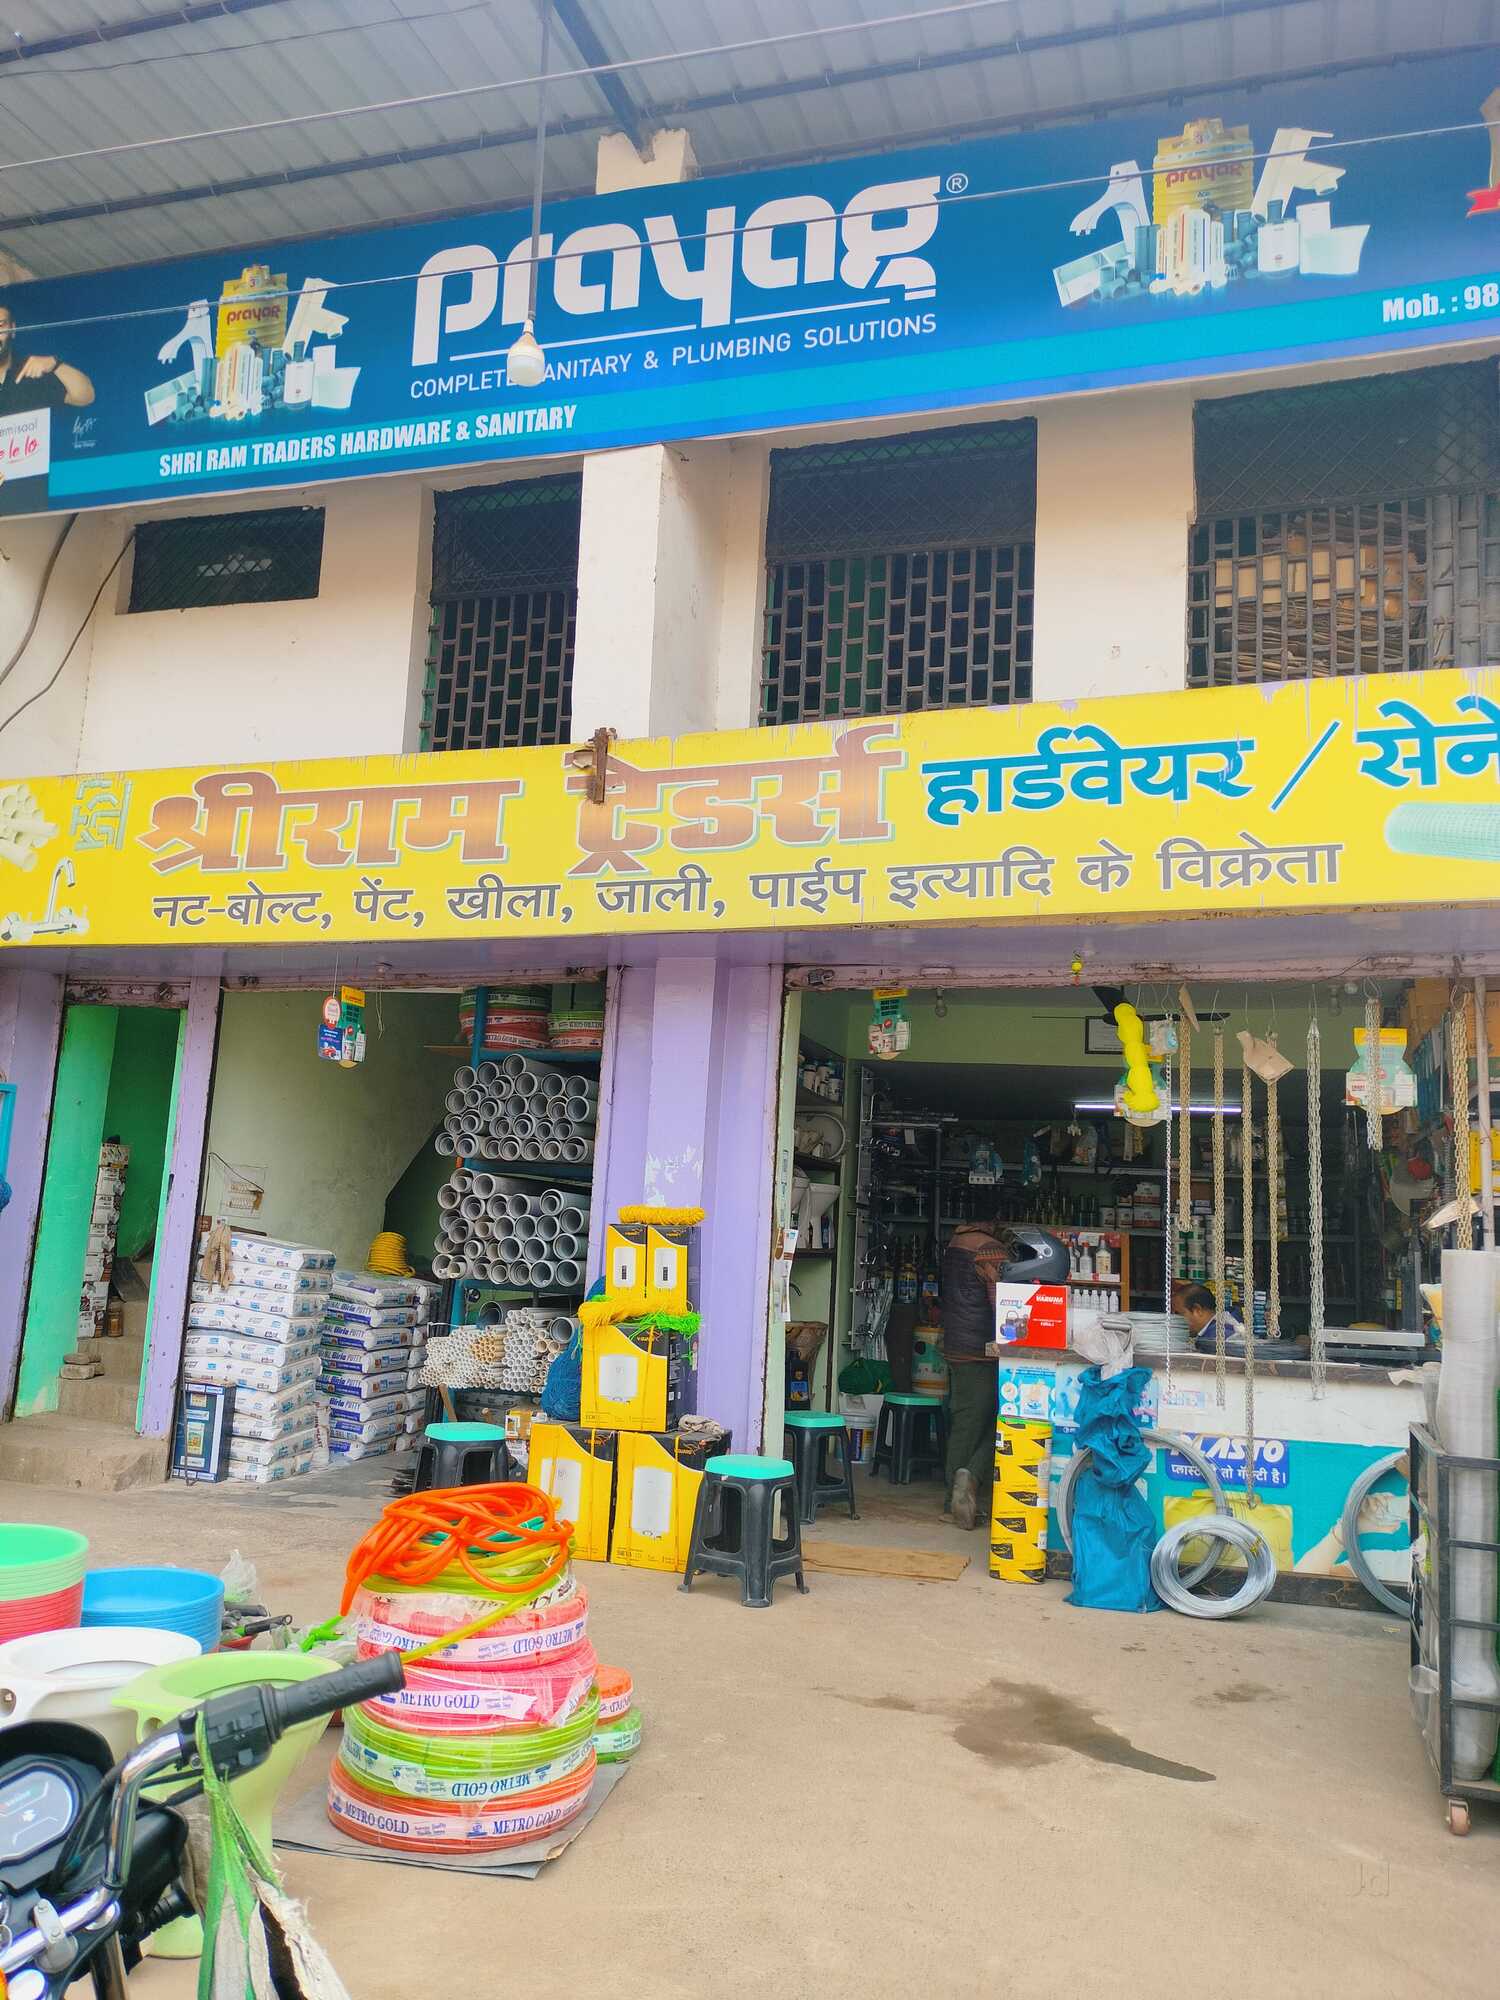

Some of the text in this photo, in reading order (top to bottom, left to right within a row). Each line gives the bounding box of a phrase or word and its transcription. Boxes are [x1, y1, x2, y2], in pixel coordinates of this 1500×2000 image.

[411, 175, 941, 367] prayag
[1382, 293, 1446, 322] Mob.
[1463, 282, 1499, 310] 98
[543, 353, 632, 383] ANITARY
[643, 350, 659, 369] &
[673, 331, 791, 366] PLUMBING
[803, 313, 937, 349] SOLUTIONS
[159, 404, 577, 477] SHRI RAM TRADERS HARDWARE & SANITARY
[138, 771, 522, 873] श्रीराम
[564, 723, 905, 878] ट्रेडर्स
[921, 725, 1255, 826] हार्डवेयर
[153, 831, 1344, 930] नट-बोल्ट, पेंट, खीला, जाली, पाईप इत्यादि के विक्रेता
[513, 1635, 544, 1654] GOLD
[545, 1629, 573, 1648] METRO
[400, 1691, 441, 1707] METRO
[444, 1694, 480, 1710] GOLD
[452, 1781, 487, 1797] GOLD
[490, 1774, 531, 1794] METRO
[345, 1801, 375, 1826] METRO
[376, 1817, 409, 1834] GOLD
[492, 1808, 562, 1834] METRO GOLD
